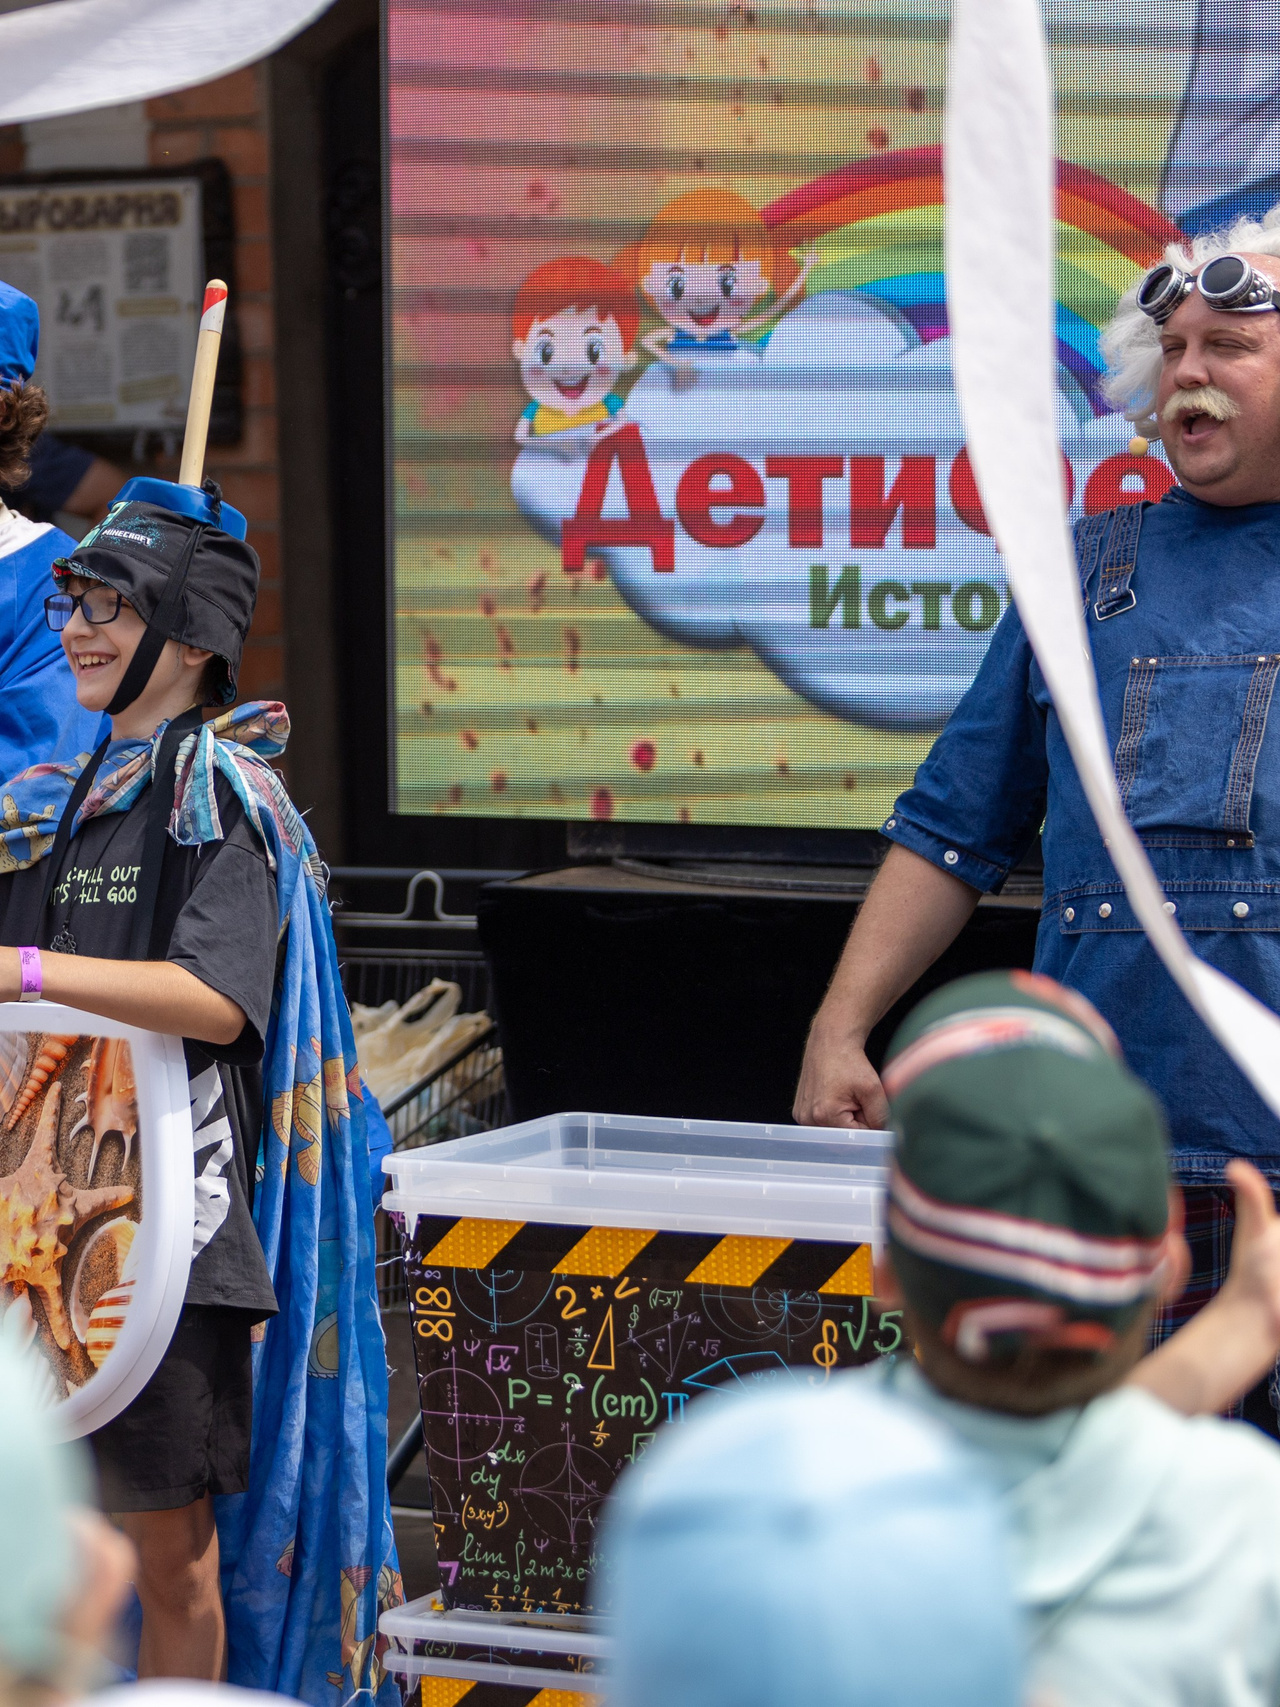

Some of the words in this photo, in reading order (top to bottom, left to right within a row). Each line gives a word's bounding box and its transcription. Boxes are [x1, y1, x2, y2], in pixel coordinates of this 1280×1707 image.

[101, 528, 153, 546] MINECRAFT
[809, 564, 1012, 631] Исто
[110, 865, 141, 882] OUT
